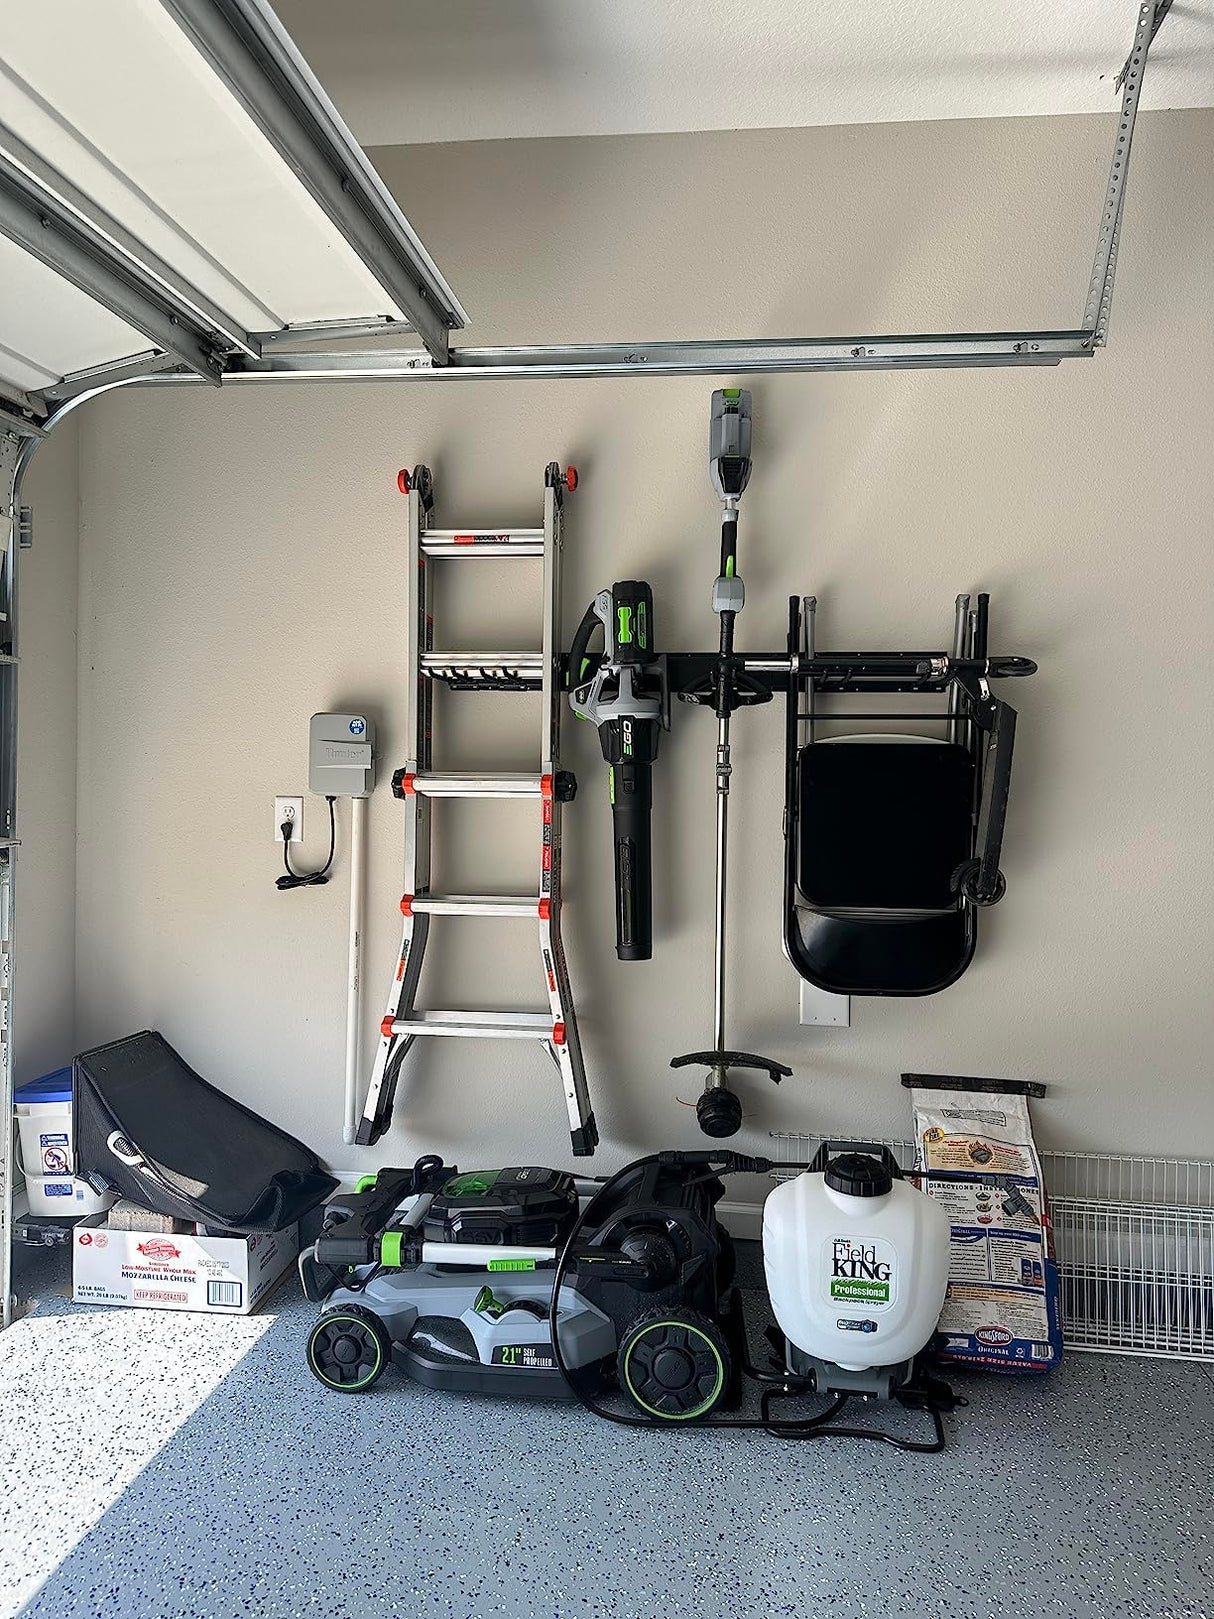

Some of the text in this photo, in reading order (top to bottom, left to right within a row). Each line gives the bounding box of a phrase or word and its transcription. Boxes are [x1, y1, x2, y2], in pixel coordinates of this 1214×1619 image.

[623, 720, 632, 756] EGO
[928, 1182, 974, 1190] DIRECTIONS
[832, 1242, 877, 1264] Field
[831, 1258, 892, 1281] KING
[121, 1271, 197, 1284] MOZZARELLA CHEESE
[136, 1290, 187, 1301] KEEP REFRIGERATED
[834, 1284, 886, 1298] Professional
[978, 1329, 1010, 1343] KINGSFORD
[502, 1346, 535, 1364] 21" SELF
[978, 1345, 1010, 1355] ORIGINAL
[523, 1356, 553, 1367] PROPELLED
[1006, 1360, 1032, 1368] VALUE
